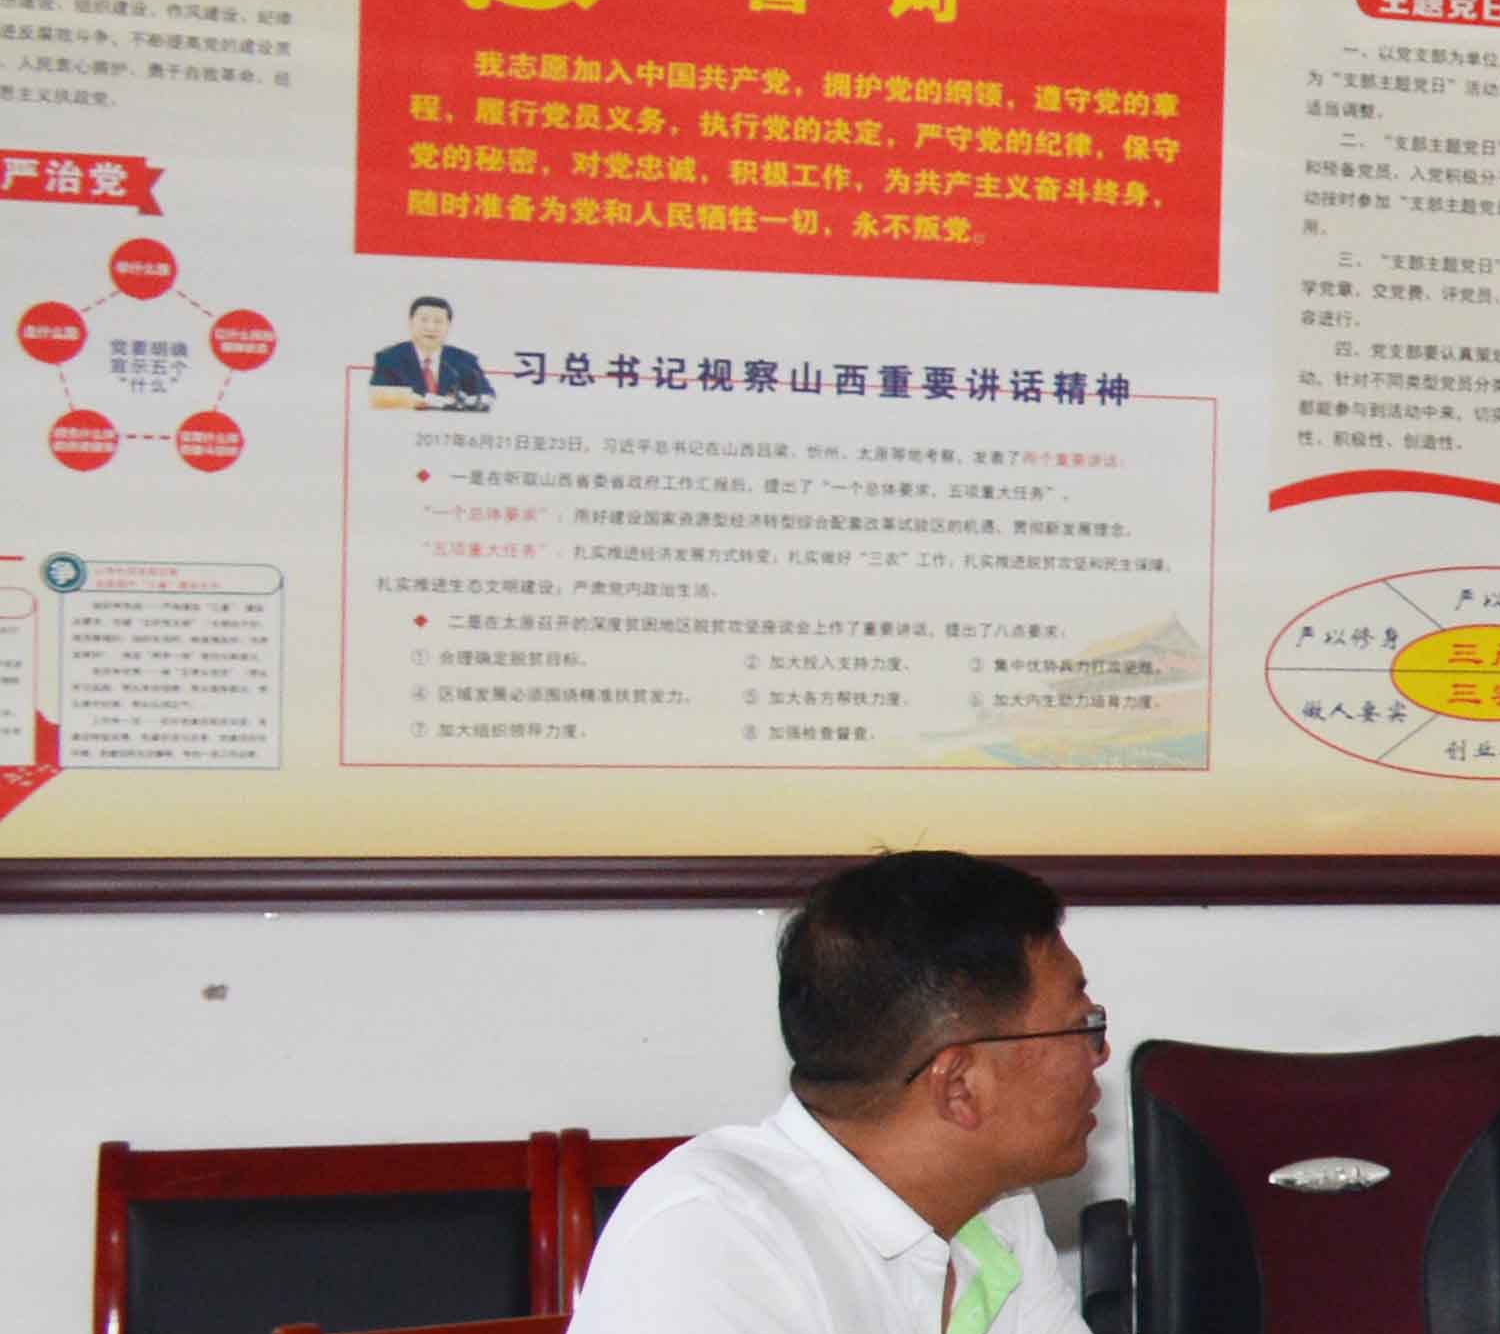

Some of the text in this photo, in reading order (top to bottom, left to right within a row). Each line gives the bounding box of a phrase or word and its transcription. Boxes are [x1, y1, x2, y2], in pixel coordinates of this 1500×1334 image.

[511, 351, 1131, 407] 习总书记视察山西重要讲话精神
[1296, 626, 1400, 651] 严以修身
[1302, 698, 1408, 723] 做人要实
